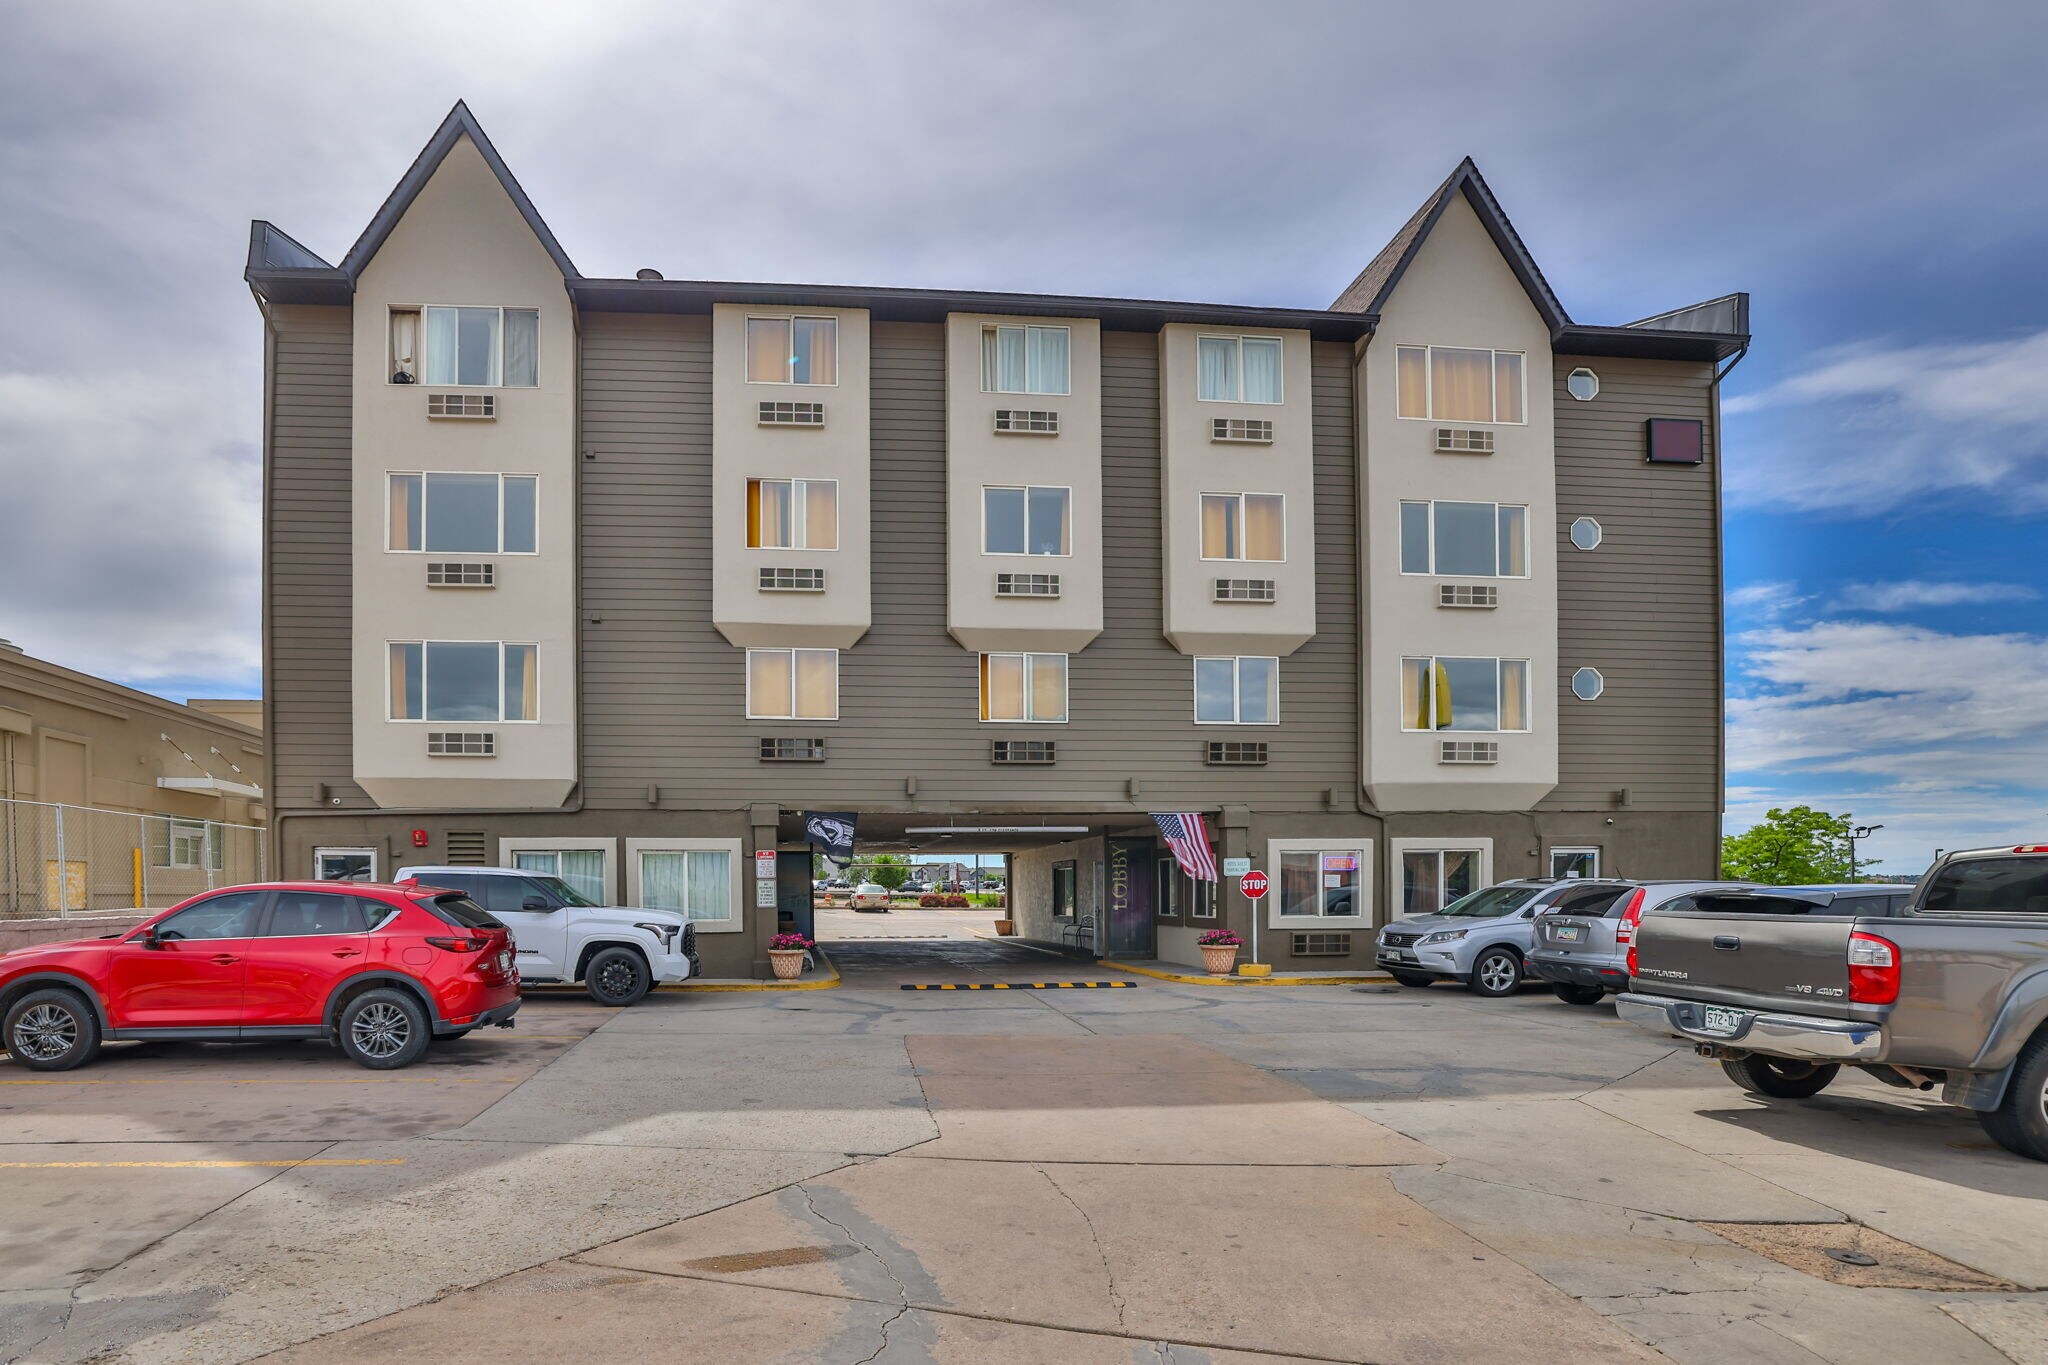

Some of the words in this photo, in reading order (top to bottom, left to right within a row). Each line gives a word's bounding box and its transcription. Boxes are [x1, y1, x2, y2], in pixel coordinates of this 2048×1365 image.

[1112, 844, 1127, 911] LOBBY
[1242, 879, 1267, 890] STOP
[1652, 969, 1688, 980] TUNDRA
[1796, 984, 1812, 994] V8
[1816, 987, 1844, 997] 4WD
